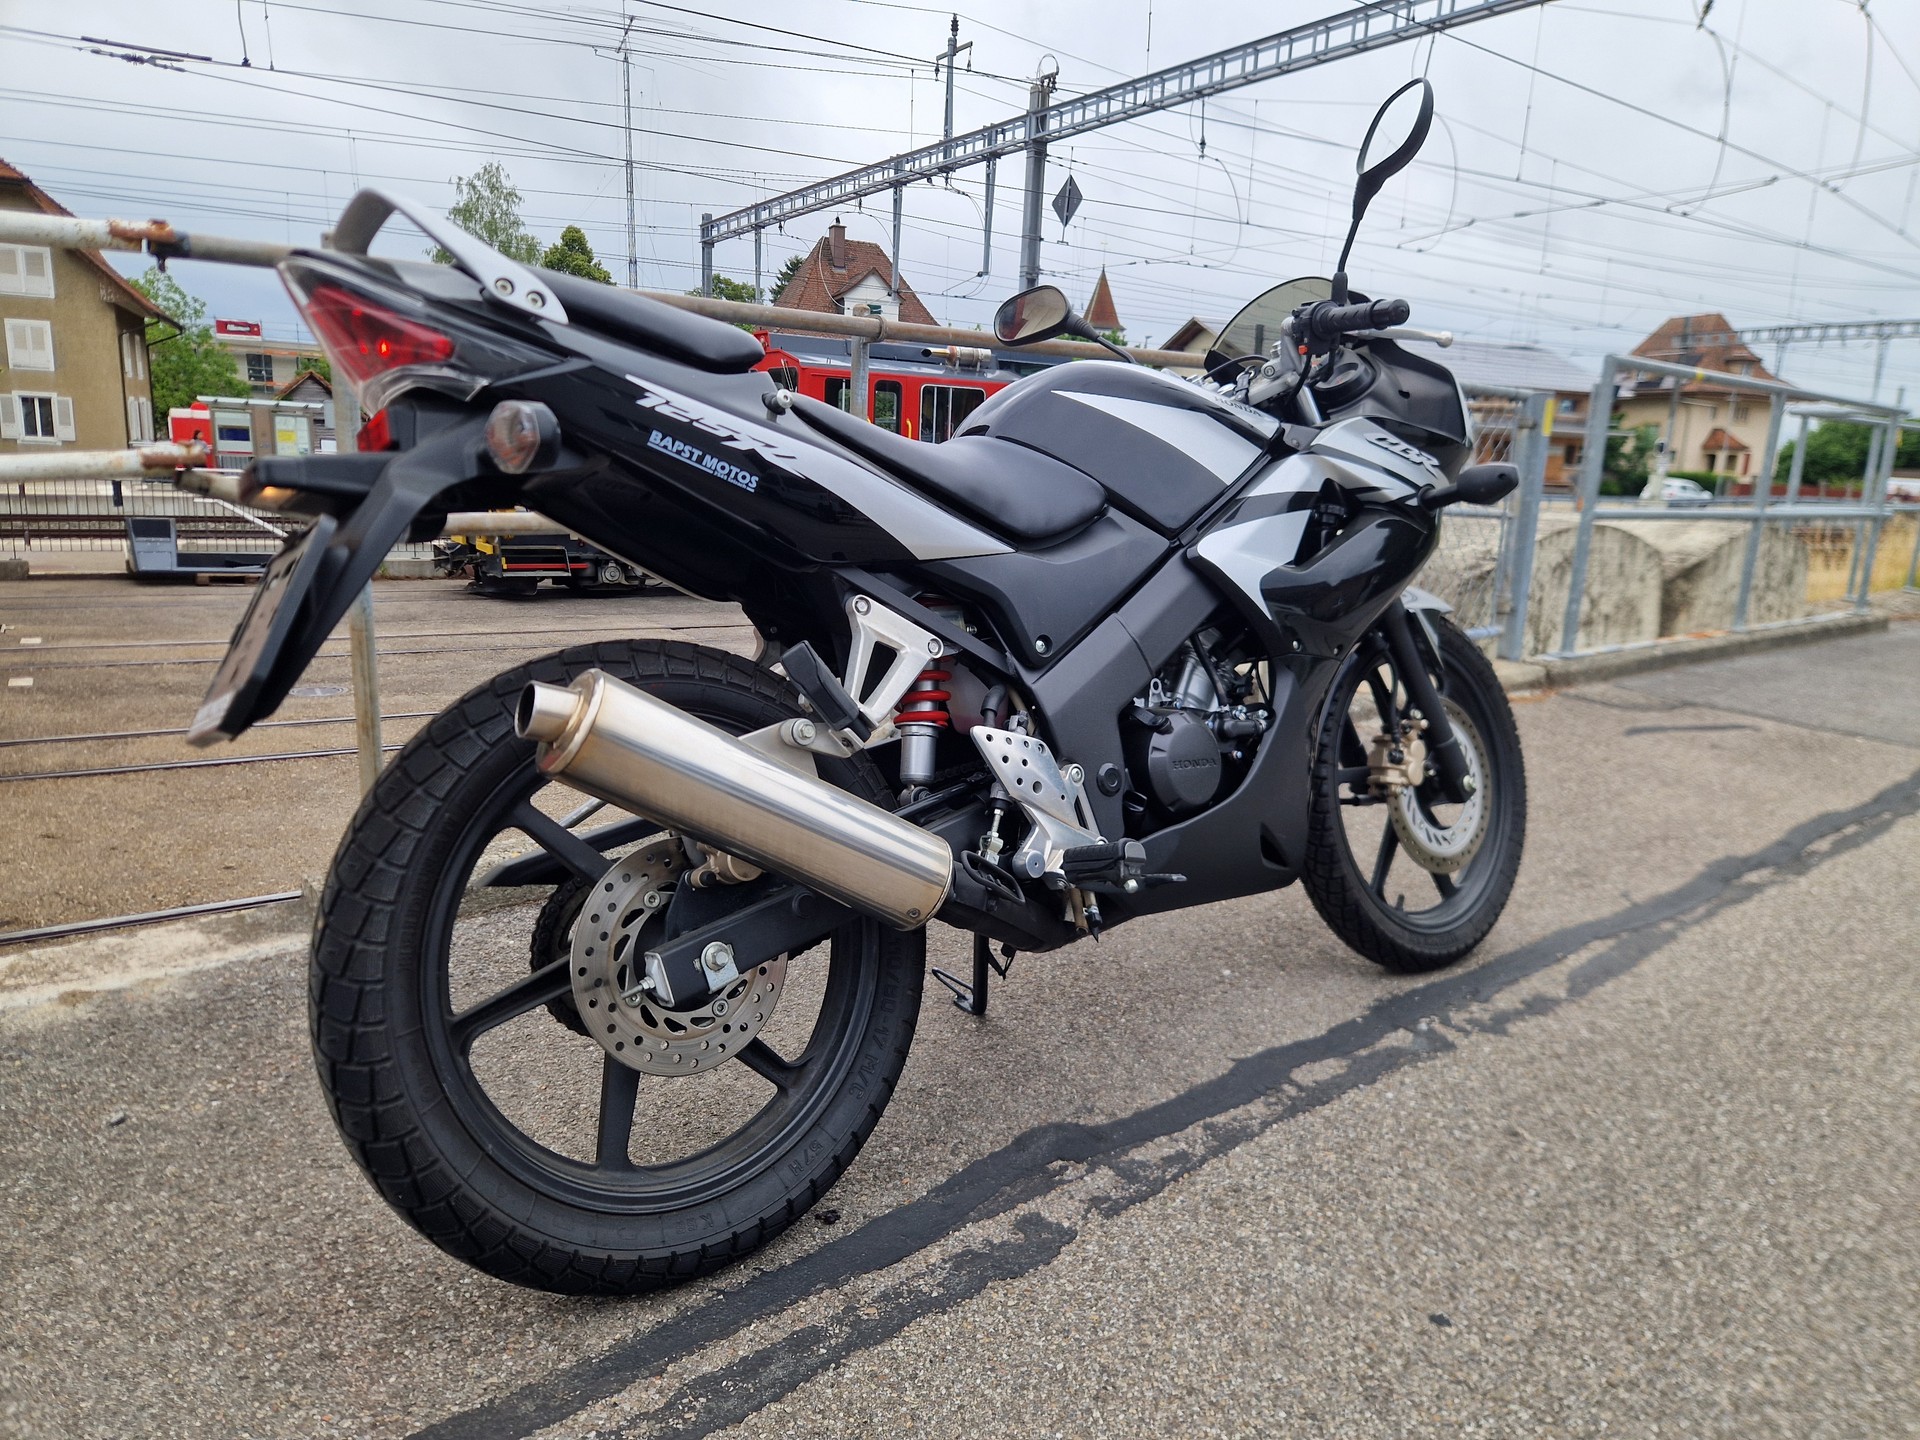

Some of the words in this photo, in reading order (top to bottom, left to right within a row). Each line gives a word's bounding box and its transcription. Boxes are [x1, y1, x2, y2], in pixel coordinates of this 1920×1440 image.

[649, 429, 703, 461] BAPST
[702, 453, 759, 488] MOTOS
[1363, 432, 1440, 479] CBR
[1172, 758, 1217, 770] HONDA
[848, 1053, 880, 1100] M/C
[787, 1138, 824, 1178] 57H
